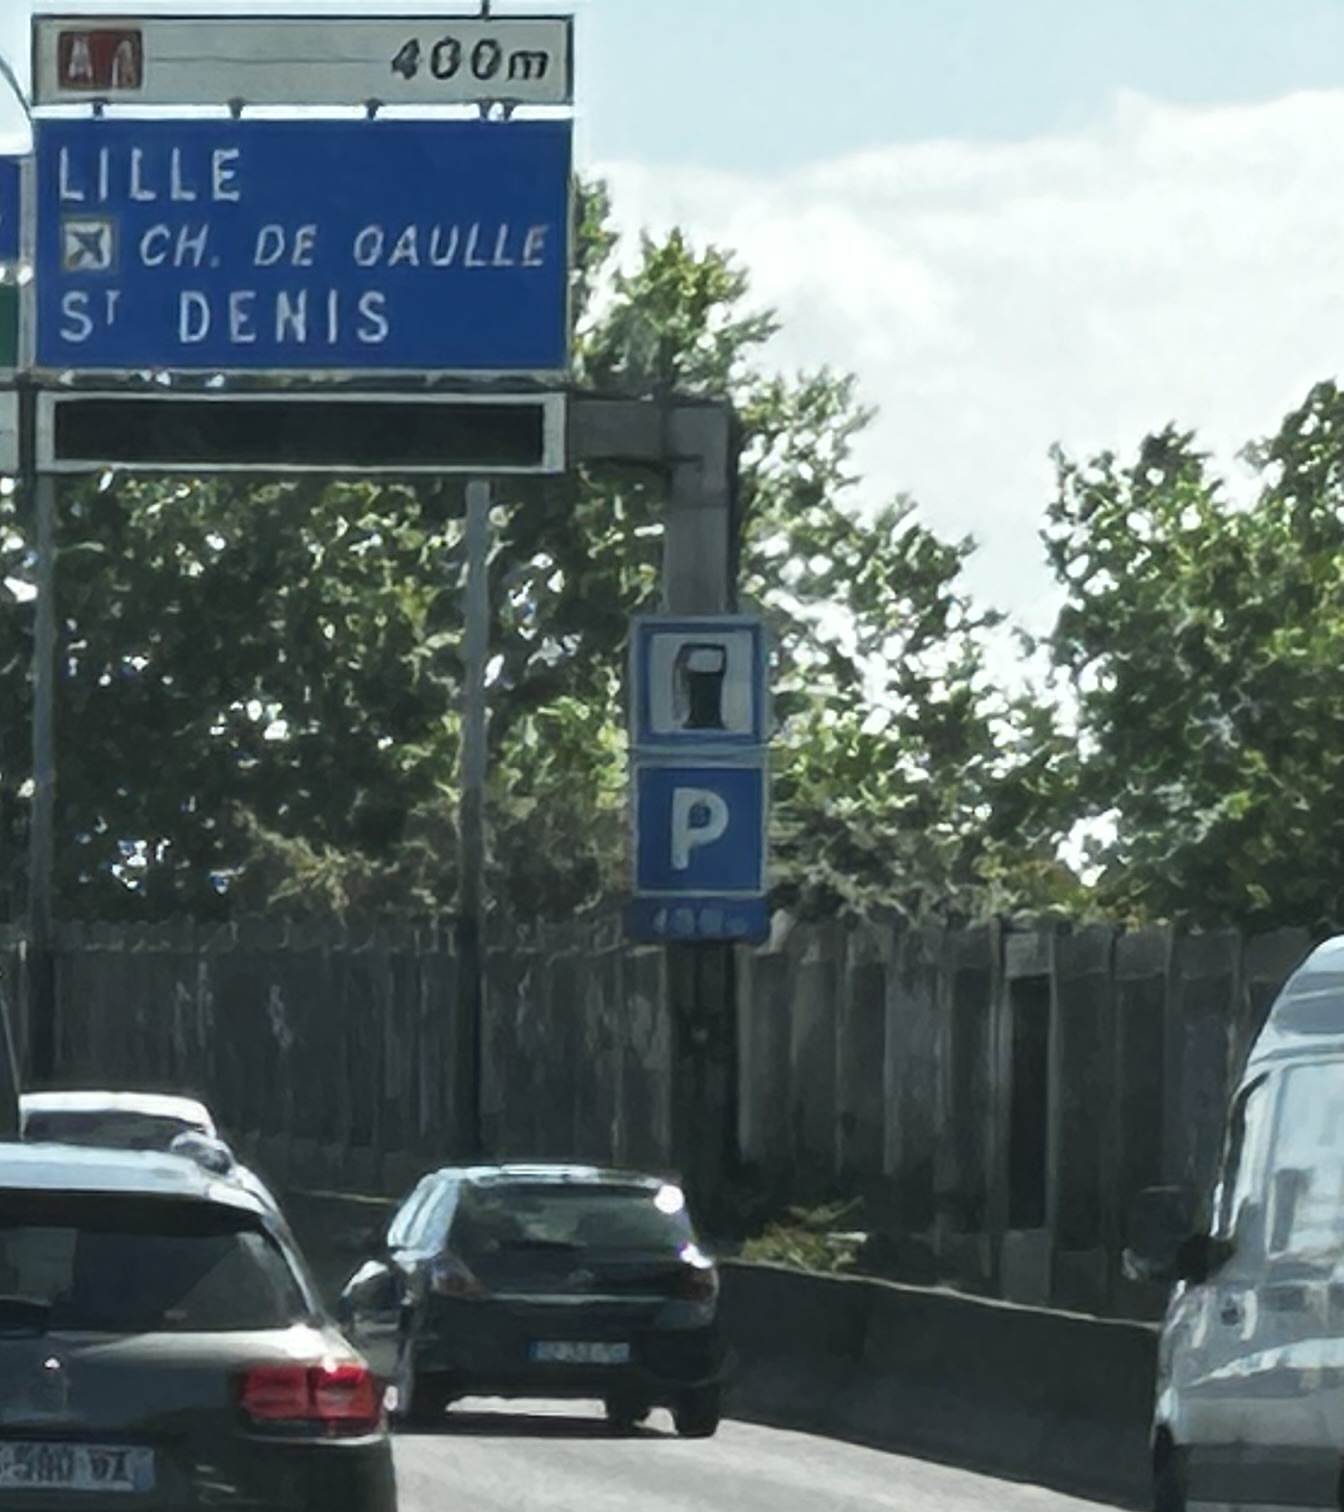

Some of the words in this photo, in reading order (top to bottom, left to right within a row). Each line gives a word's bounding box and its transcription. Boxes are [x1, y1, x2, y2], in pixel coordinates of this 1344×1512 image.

[389, 37, 551, 82] 400m
[59, 146, 242, 202] LILLE
[139, 224, 221, 268] CH.
[253, 224, 317, 267] DE
[178, 289, 390, 343] DENIS
[670, 786, 730, 871] P
